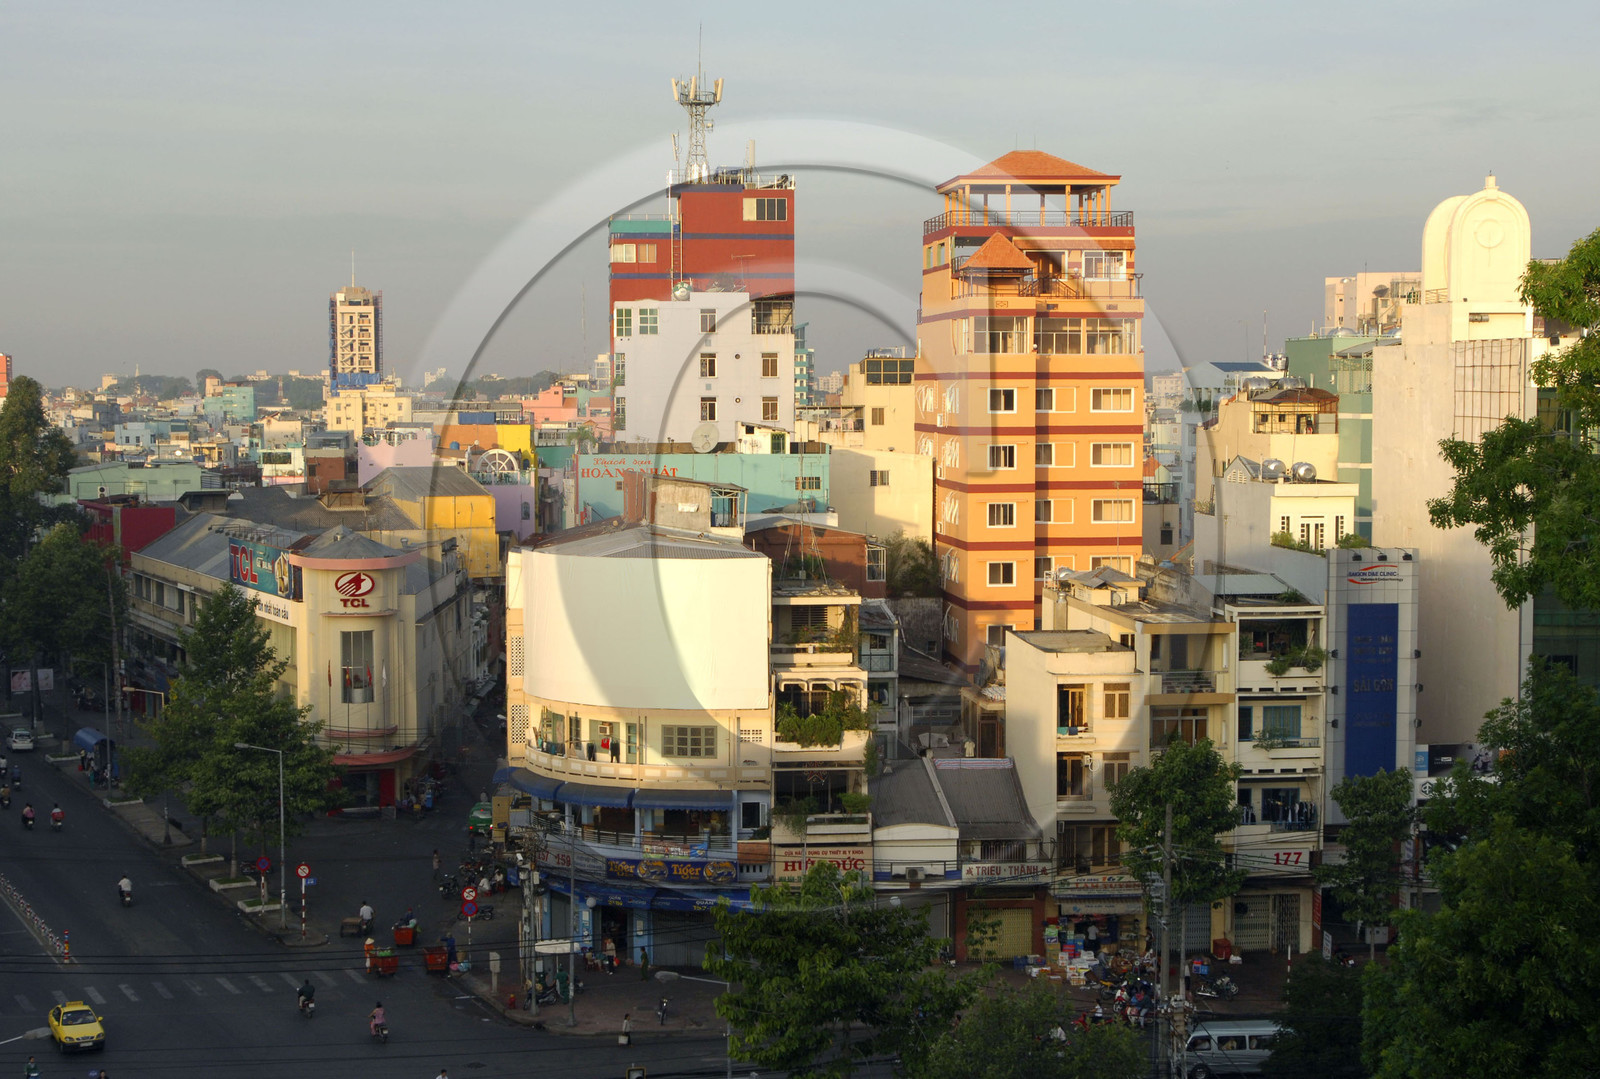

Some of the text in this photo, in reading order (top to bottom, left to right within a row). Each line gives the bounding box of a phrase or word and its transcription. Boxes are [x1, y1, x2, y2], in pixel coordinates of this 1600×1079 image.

[230, 544, 258, 584] TCL
[340, 598, 370, 608] TCL
[556, 854, 571, 867] 159
[1273, 852, 1302, 865] 177
[608, 860, 636, 877] Tiger
[671, 864, 702, 880] Tiger
